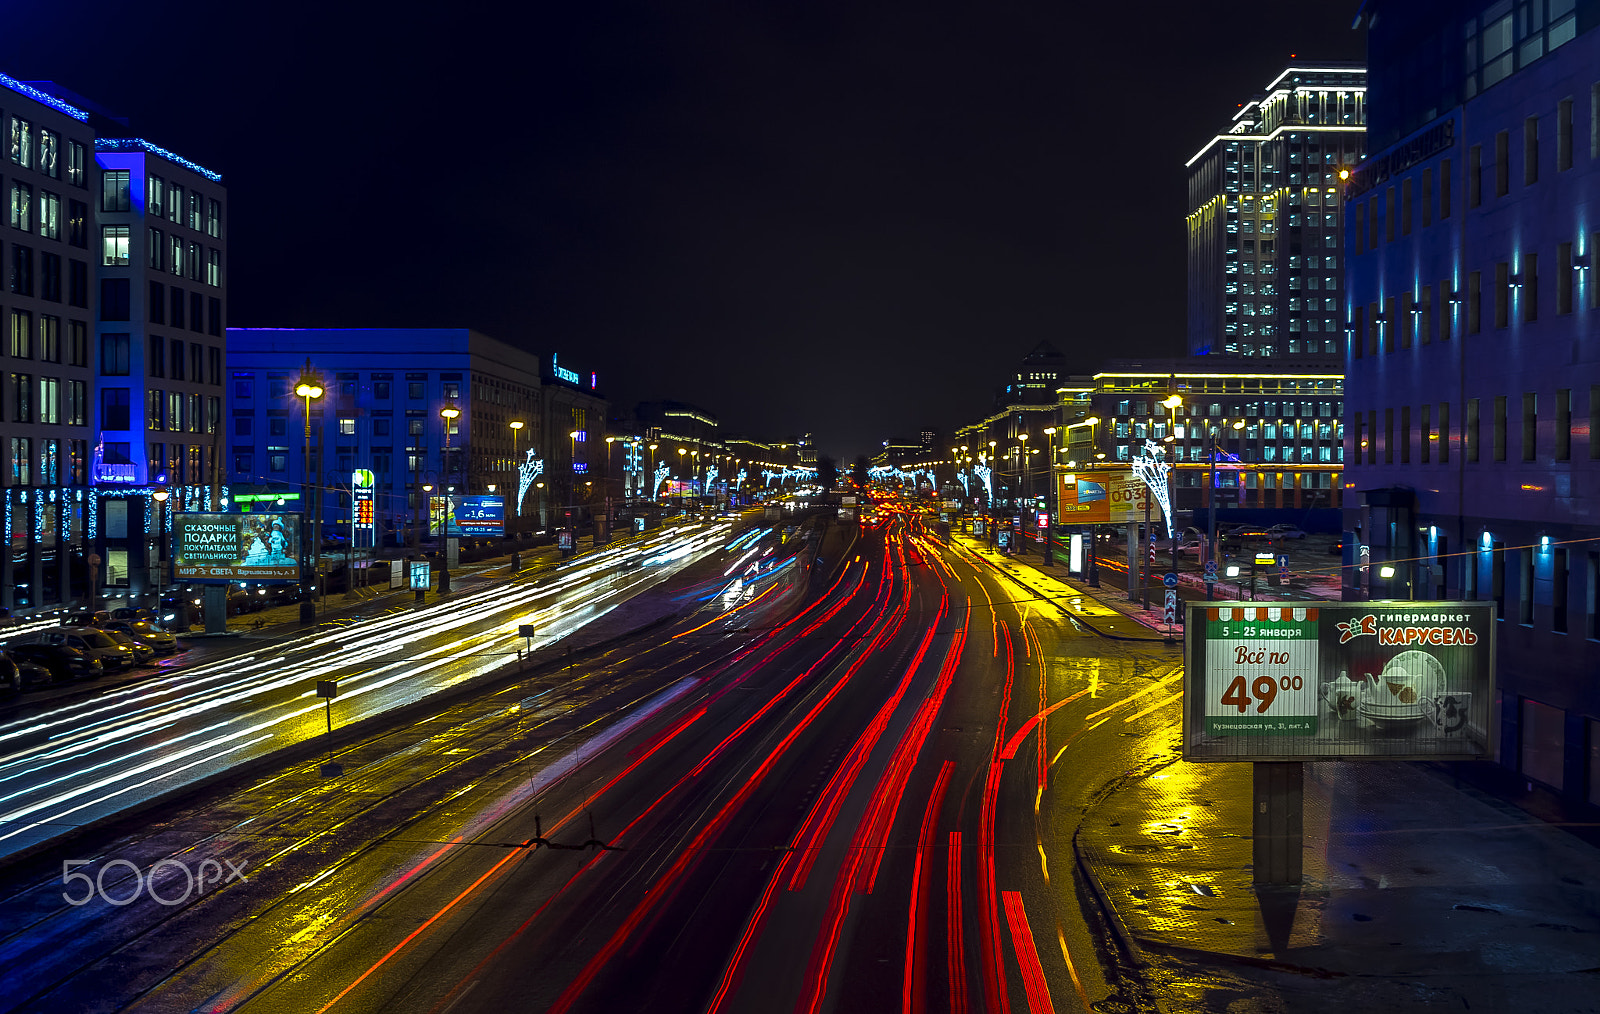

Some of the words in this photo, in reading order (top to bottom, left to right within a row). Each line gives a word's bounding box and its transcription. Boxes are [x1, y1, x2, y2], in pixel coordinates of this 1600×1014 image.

[184, 533, 237, 544] ПОДАРКИ
[183, 544, 237, 552] ПОКУПАТЕЛЯМ
[1380, 614, 1471, 624] гипермаркет
[1222, 627, 1230, 636] 5
[1243, 627, 1256, 636] 25
[1259, 628, 1302, 639] января
[1379, 627, 1478, 645] КАРУСЕЛЬ
[1234, 645, 1267, 665] Всё
[1269, 652, 1290, 665] по
